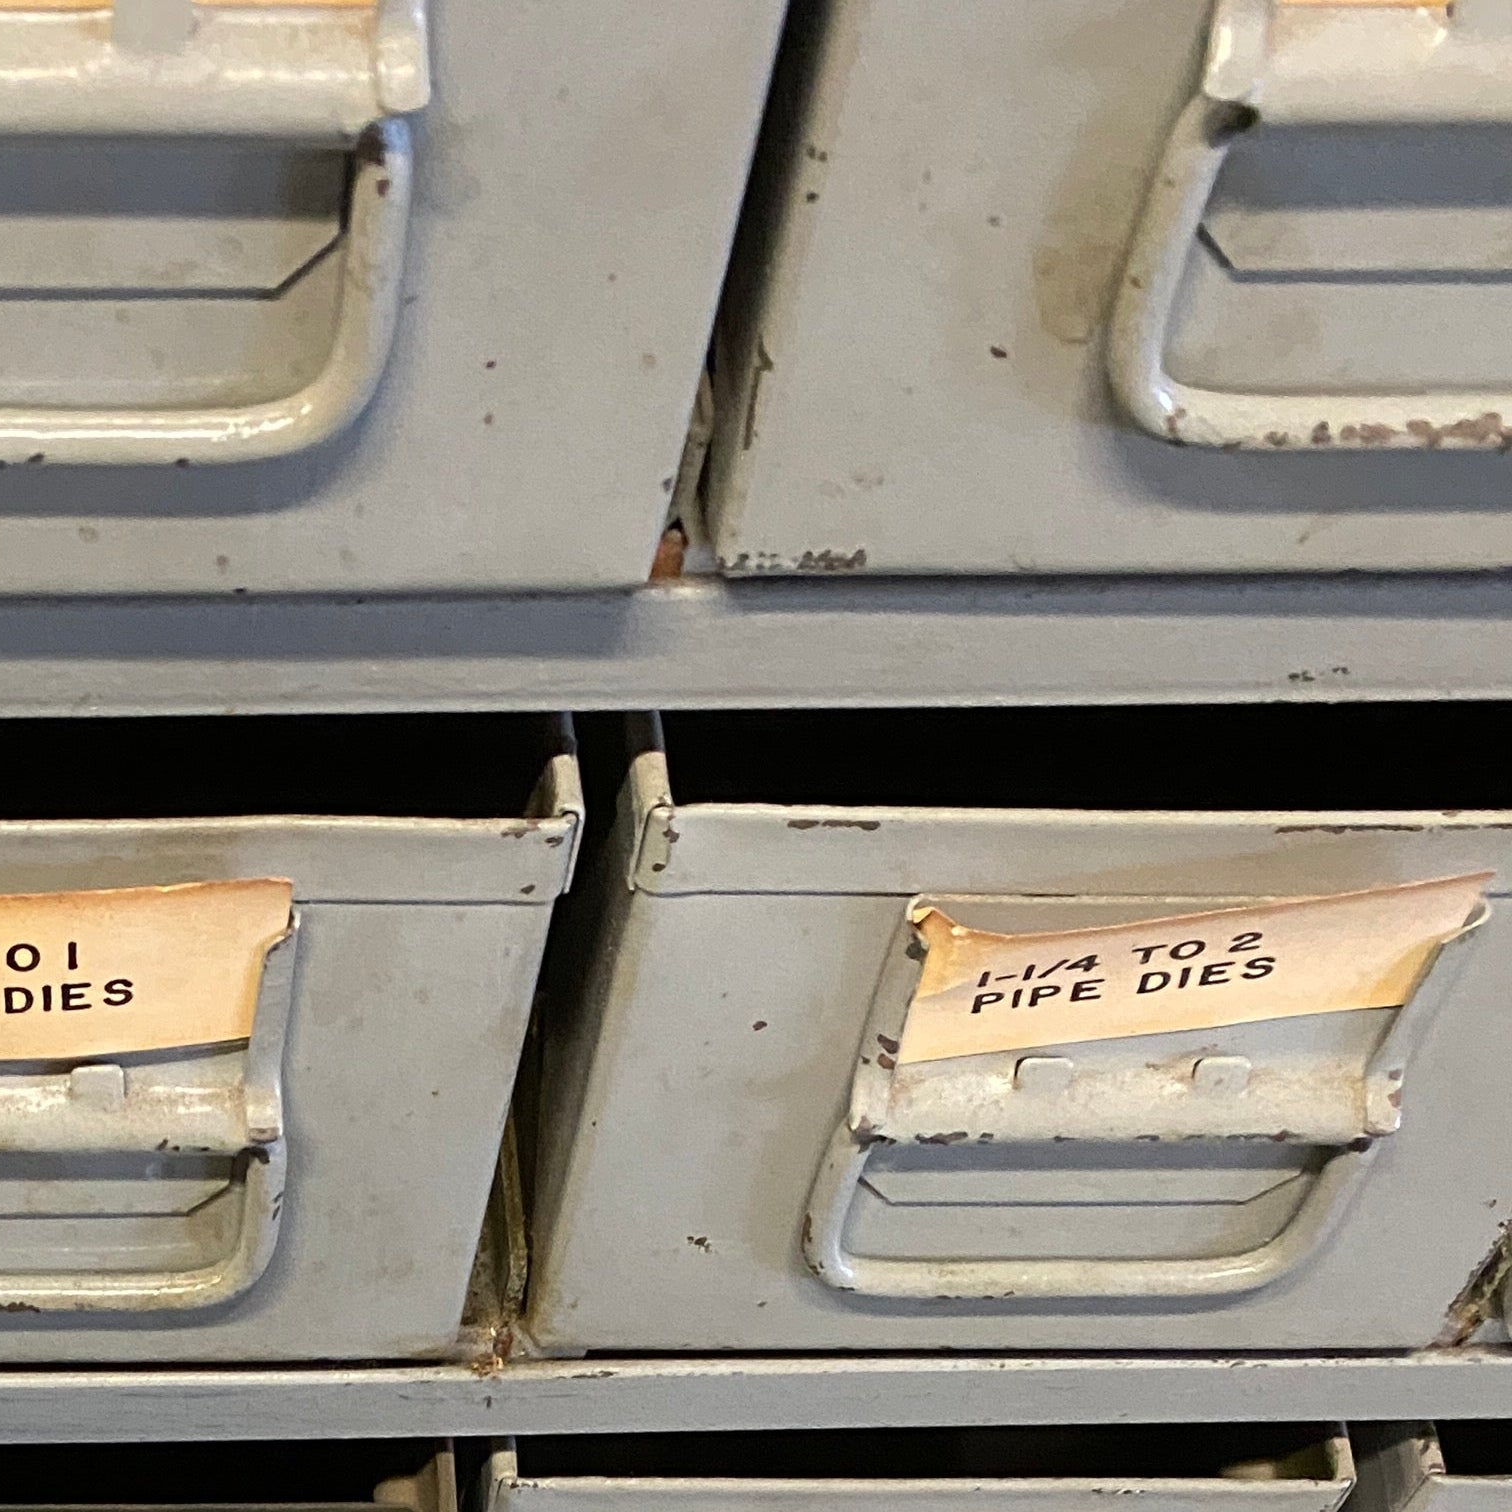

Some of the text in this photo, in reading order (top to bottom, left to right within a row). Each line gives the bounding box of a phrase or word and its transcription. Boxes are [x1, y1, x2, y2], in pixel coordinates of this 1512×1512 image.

[969, 956, 1276, 1014] PIPE DIES
[976, 931, 1263, 988] 1-1/4 TO 2
[3, 978, 135, 1015] DIES
